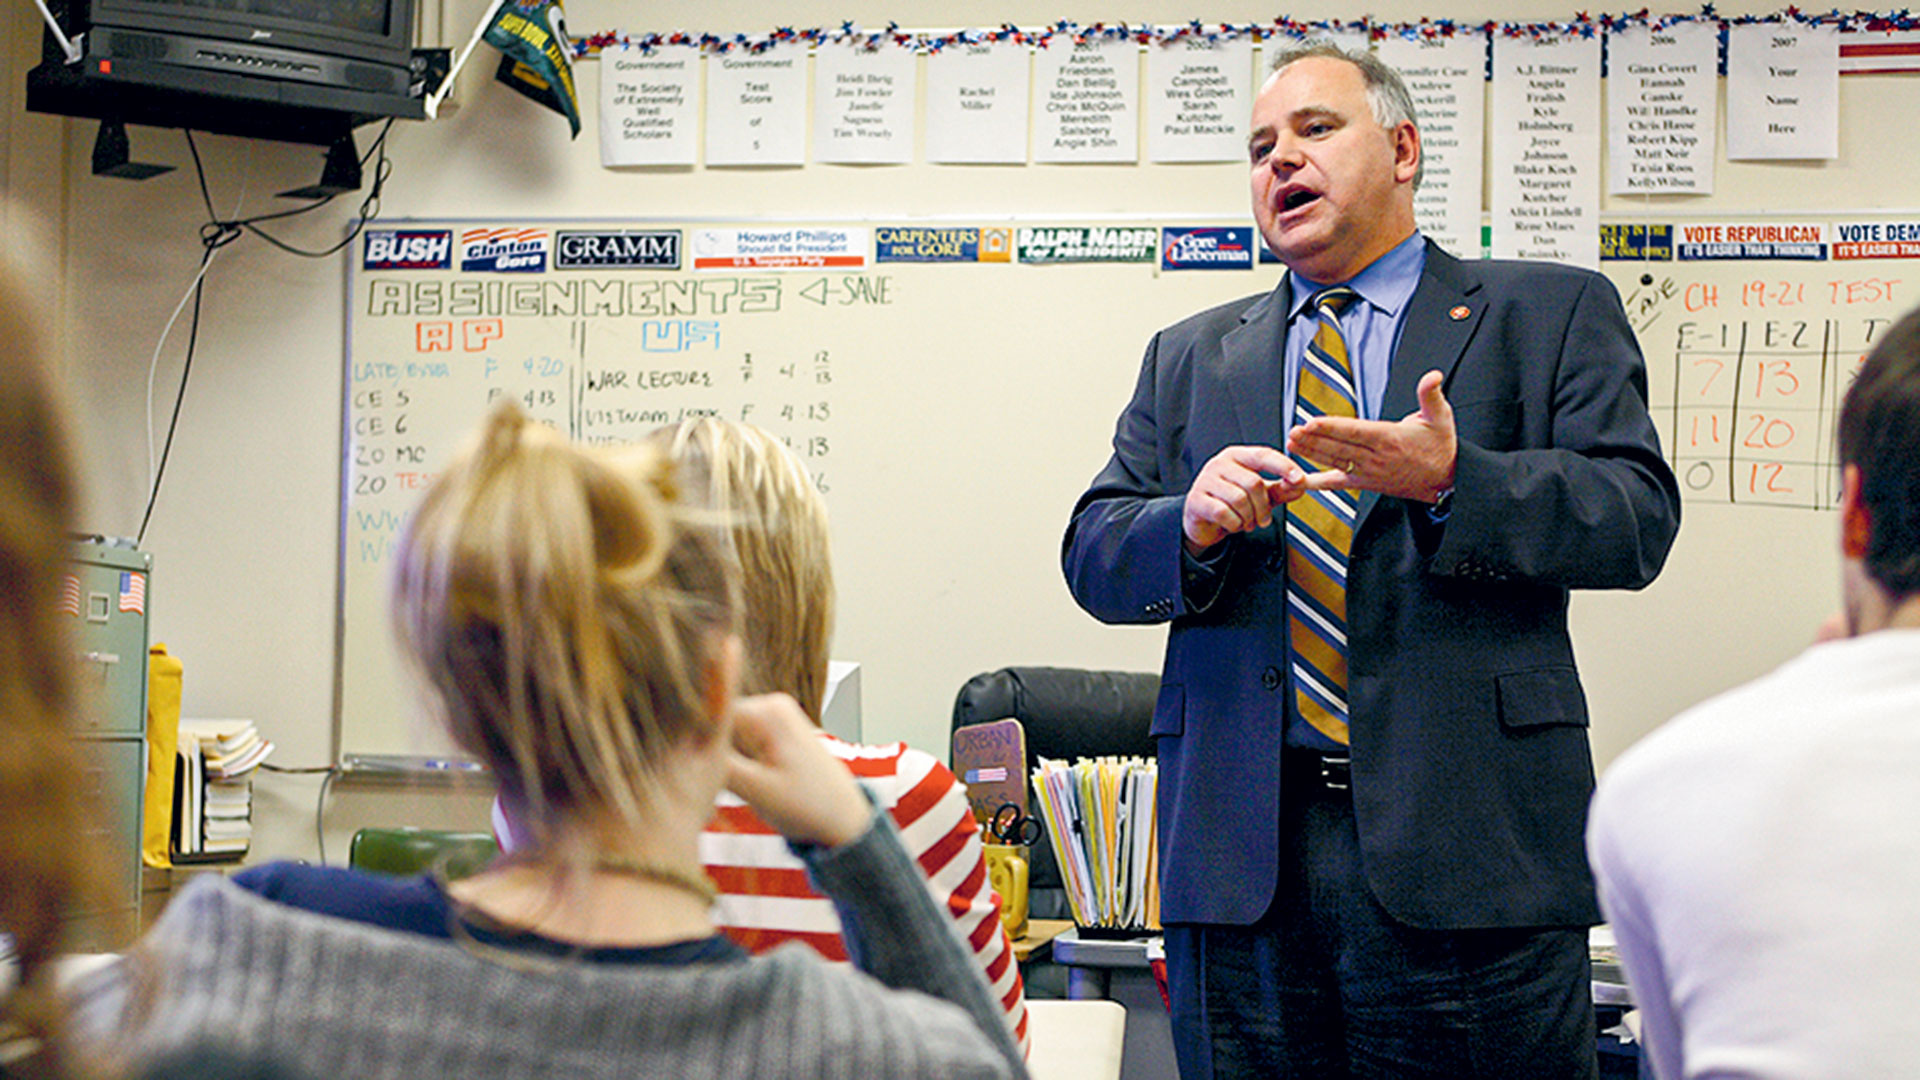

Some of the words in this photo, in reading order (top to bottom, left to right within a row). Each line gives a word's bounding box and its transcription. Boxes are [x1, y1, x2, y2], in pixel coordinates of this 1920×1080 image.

[1650, 35, 1676, 46] 2006
[1771, 37, 1798, 49] 2007
[723, 58, 793, 69] Government
[1069, 54, 1105, 64] Aaron
[614, 60, 685, 71] Government
[1059, 66, 1114, 75] Friedman
[1180, 65, 1219, 75] James
[1442, 66, 1468, 76] Case
[1627, 64, 1656, 74] Gina
[1658, 64, 1697, 74] Covert
[1768, 66, 1798, 78] Your
[745, 82, 769, 92] Test
[1056, 78, 1080, 88] Dan
[1171, 77, 1228, 88] Campbell
[1528, 80, 1566, 91] Angela
[617, 83, 637, 93] The
[640, 83, 683, 95] Society
[959, 87, 995, 97] Rachel
[1071, 90, 1123, 99] Johnson
[1165, 89, 1191, 99] Wes
[1194, 88, 1235, 98] Gilbert
[613, 95, 626, 105] of
[628, 95, 684, 106] Extremely
[740, 94, 773, 104] Score
[1766, 95, 1799, 106] Name
[961, 101, 992, 110] Miller
[1046, 102, 1077, 112] Chris
[1183, 101, 1218, 110] Sarah
[636, 107, 661, 116] Well
[1533, 108, 1559, 118] Kyle
[623, 117, 674, 129] Qualified
[749, 117, 762, 127] of
[1060, 114, 1112, 123] Meredith
[1176, 113, 1223, 122] Kutcher
[1060, 126, 1110, 137] Salsbery
[1164, 125, 1190, 135] Paul
[1194, 125, 1235, 134] Mackie
[1518, 121, 1574, 132] Holmberg
[1768, 124, 1797, 134] Here
[623, 129, 673, 139] Scholars
[753, 140, 760, 150] 5
[1054, 138, 1086, 150] Angie
[1091, 138, 1118, 148] Shin
[1530, 137, 1561, 148] Joyce
[1669, 135, 1698, 147] Kipp
[1523, 151, 1568, 161] Johnson
[1634, 149, 1662, 159] Matt
[1513, 166, 1544, 175] Blake
[1547, 166, 1577, 175] Koch
[1519, 178, 1572, 189] Margaret
[1522, 194, 1567, 203] Kutcher
[1510, 208, 1539, 217] Alicia
[1543, 208, 1582, 217] Lindell
[737, 231, 792, 243] Howard
[796, 231, 847, 244] Phillips
[877, 229, 978, 244] CARPENTERS
[1019, 228, 1084, 247] RALPH
[1087, 228, 1156, 247] NADER
[1683, 226, 1723, 243] VOTE
[1726, 225, 1821, 243] REPUBLICAN
[1838, 224, 1881, 242] VOTE
[563, 236, 673, 258] GRAMM
[1179, 234, 1217, 249] Gore
[366, 237, 450, 262] BUSH
[467, 239, 541, 258] Clinton
[737, 244, 776, 254] Should
[779, 244, 792, 253] Be
[796, 244, 847, 253] President
[892, 245, 915, 255] FOR
[917, 243, 962, 256] GORE
[1172, 246, 1250, 261] Lieberman
[1838, 244, 1859, 257] IT'S
[1861, 243, 1898, 256] EASIER
[496, 254, 542, 269] Gore
[368, 278, 782, 317] ASSIGNMENTS
[839, 276, 893, 305] SAVE
[1684, 282, 1718, 312] CH
[1742, 279, 1804, 307] 19-21
[1828, 277, 1902, 304] TEST
[416, 318, 503, 353] AP
[587, 369, 630, 391] WAR
[637, 370, 714, 391] LECTURE
[1694, 358, 1725, 396] 7
[1756, 360, 1800, 398] 13
[354, 391, 383, 408] CE
[585, 408, 669, 426] VIETNAM
[355, 416, 384, 435] CE
[395, 414, 407, 434] 6
[1691, 414, 1719, 447] 11
[1743, 413, 1796, 449] 20
[355, 446, 385, 466] 20
[396, 445, 426, 463] MC
[1750, 462, 1793, 493] 12
[355, 474, 387, 495] 20
